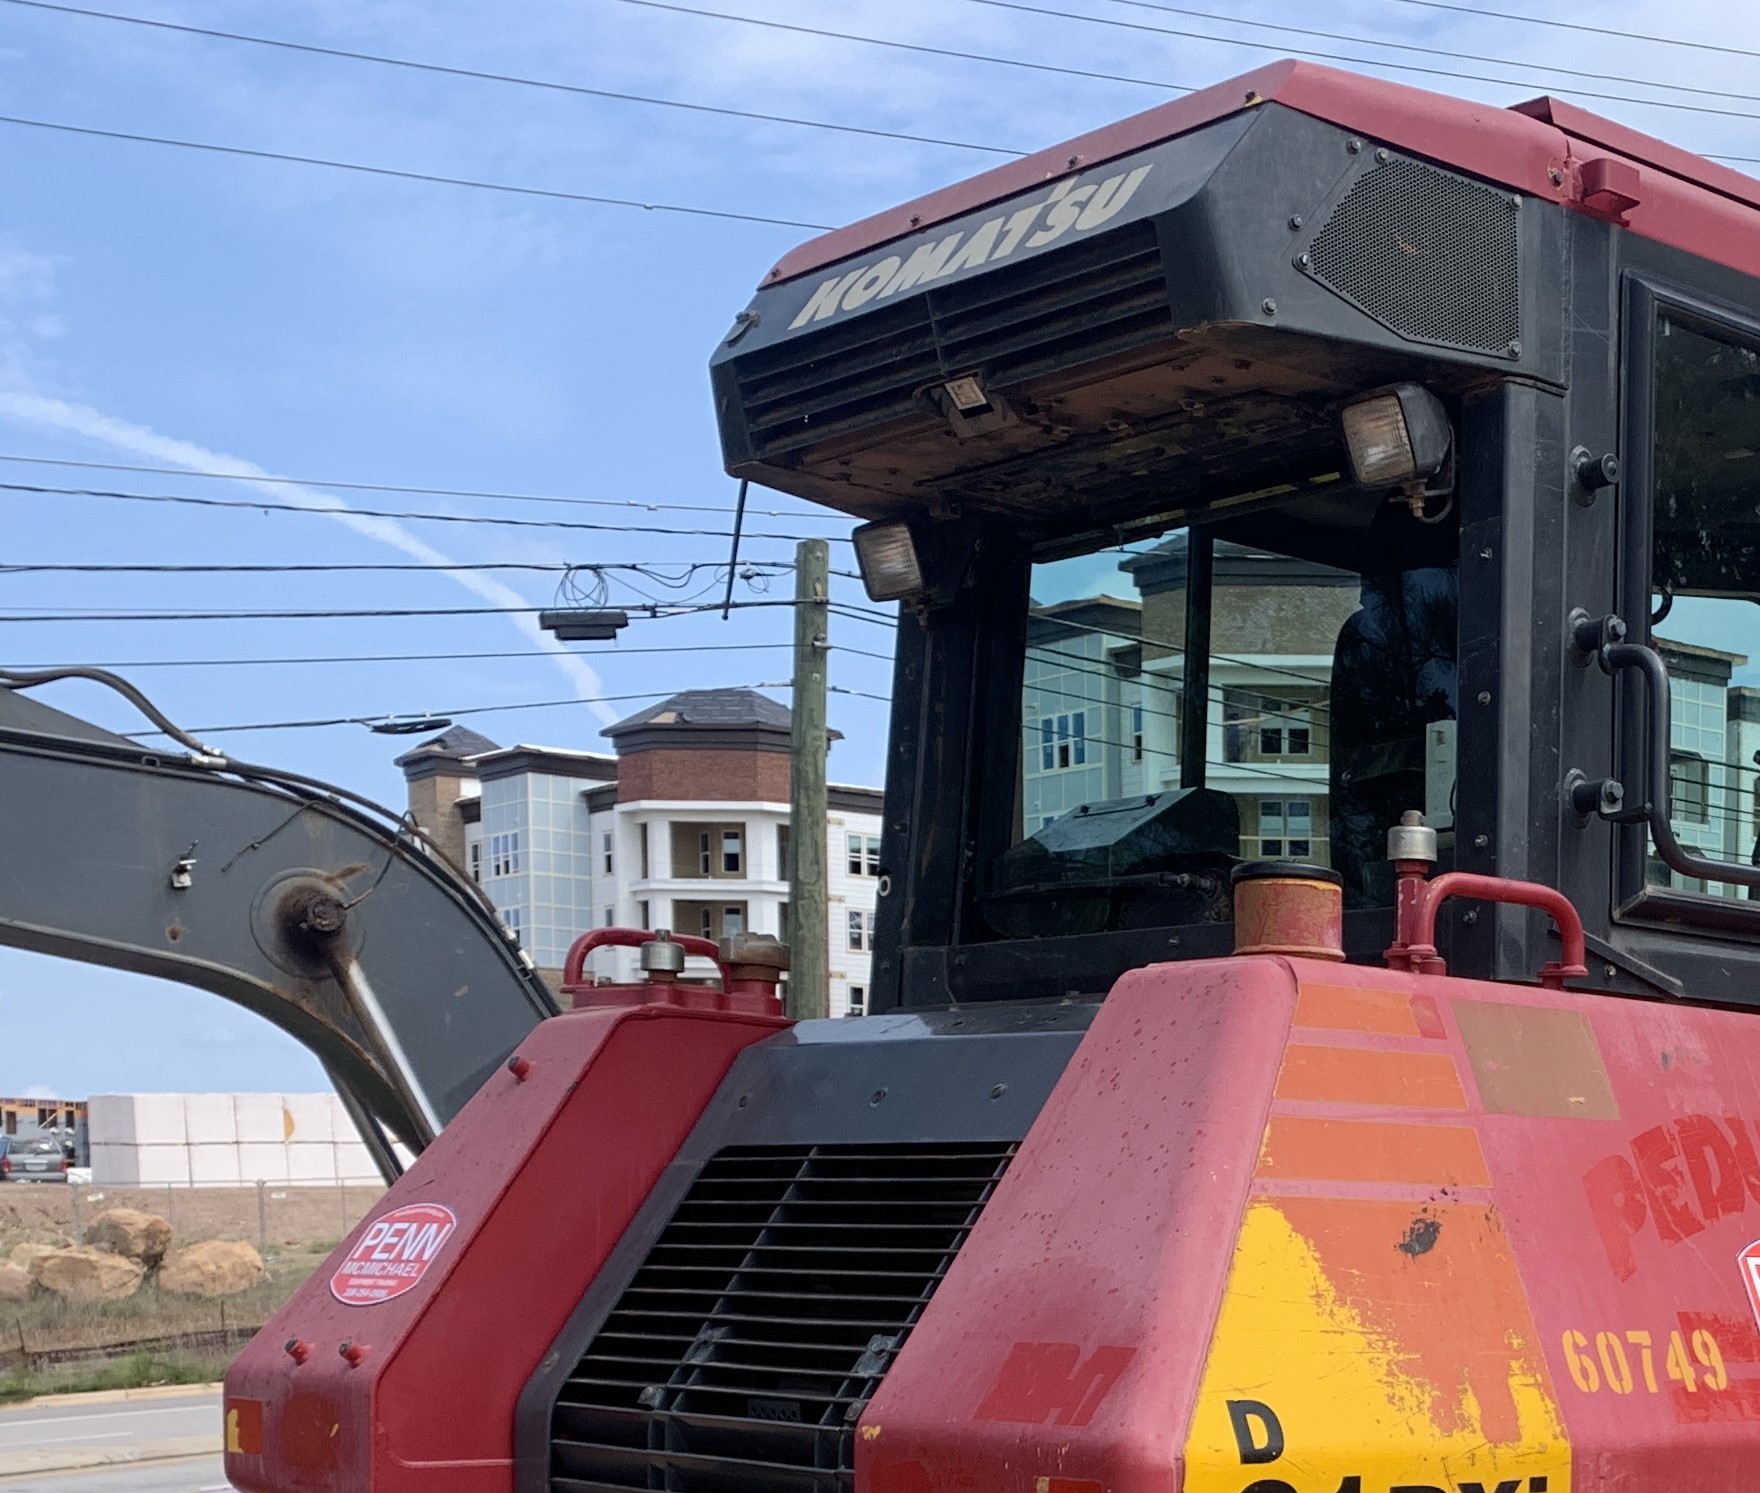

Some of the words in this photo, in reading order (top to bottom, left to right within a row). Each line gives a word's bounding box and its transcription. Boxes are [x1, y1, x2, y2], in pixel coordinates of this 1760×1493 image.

[788, 164, 1153, 331] KOMATSU
[341, 1261, 420, 1277] MCMICHAEL
[353, 1222, 452, 1261] PENN
[1562, 1329, 1728, 1394] 60749
[1226, 1399, 1285, 1465] D
